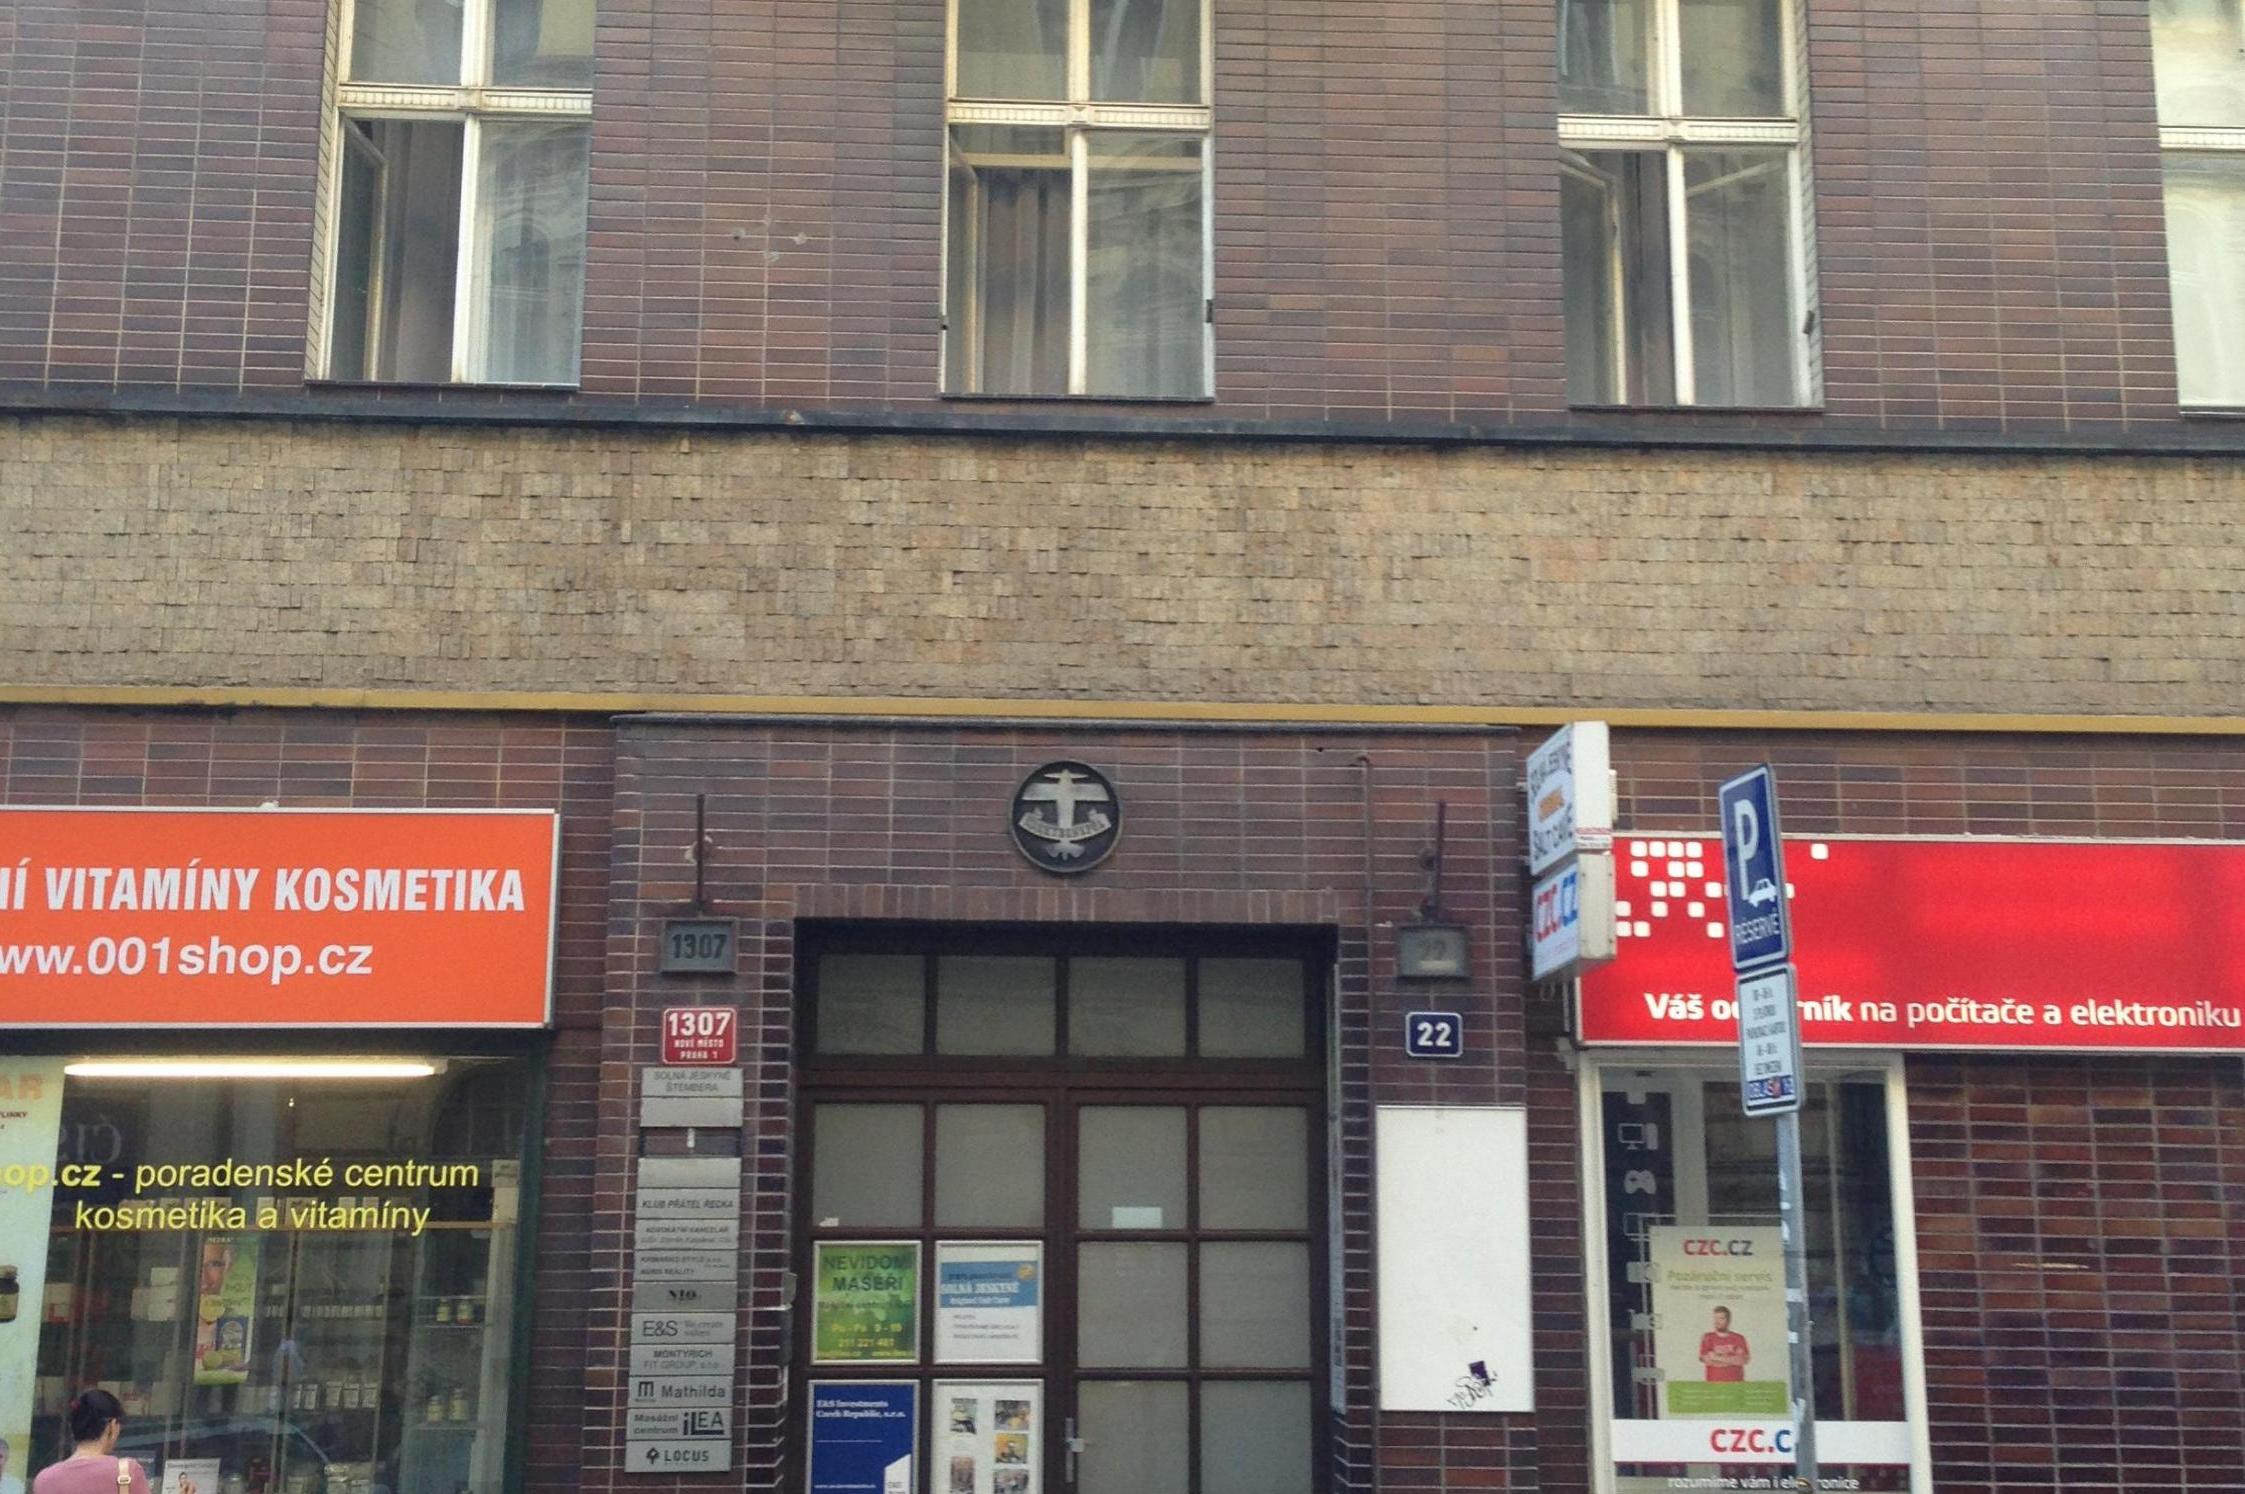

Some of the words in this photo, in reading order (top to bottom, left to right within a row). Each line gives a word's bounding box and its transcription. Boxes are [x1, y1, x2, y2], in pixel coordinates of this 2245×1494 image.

[46, 857, 260, 911] VITAMÍNY
[274, 866, 525, 912] KOSMETIKA
[672, 933, 728, 959] 1307
[669, 1011, 731, 1037] 1307
[1645, 993, 1704, 1021] Váš
[1860, 1002, 1897, 1022] na
[1907, 996, 2035, 1029] počítače
[2043, 1003, 2062, 1025] a
[2070, 998, 2242, 1027] elektroniku
[1416, 1021, 1452, 1047] 22
[135, 1157, 334, 1194] poradenské
[345, 1160, 479, 1187] centrum
[75, 1200, 246, 1230] kosmetika
[258, 1209, 278, 1229] a
[291, 1201, 431, 1237] vitamíny
[1683, 1239, 1753, 1257] CZC.CZ
[642, 1320, 679, 1337] E&S
[661, 1383, 726, 1399] Mathilda
[1709, 1428, 1792, 1453] CZC.C
[664, 1450, 710, 1462] LOCUS
[1740, 1476, 1772, 1490] vám
